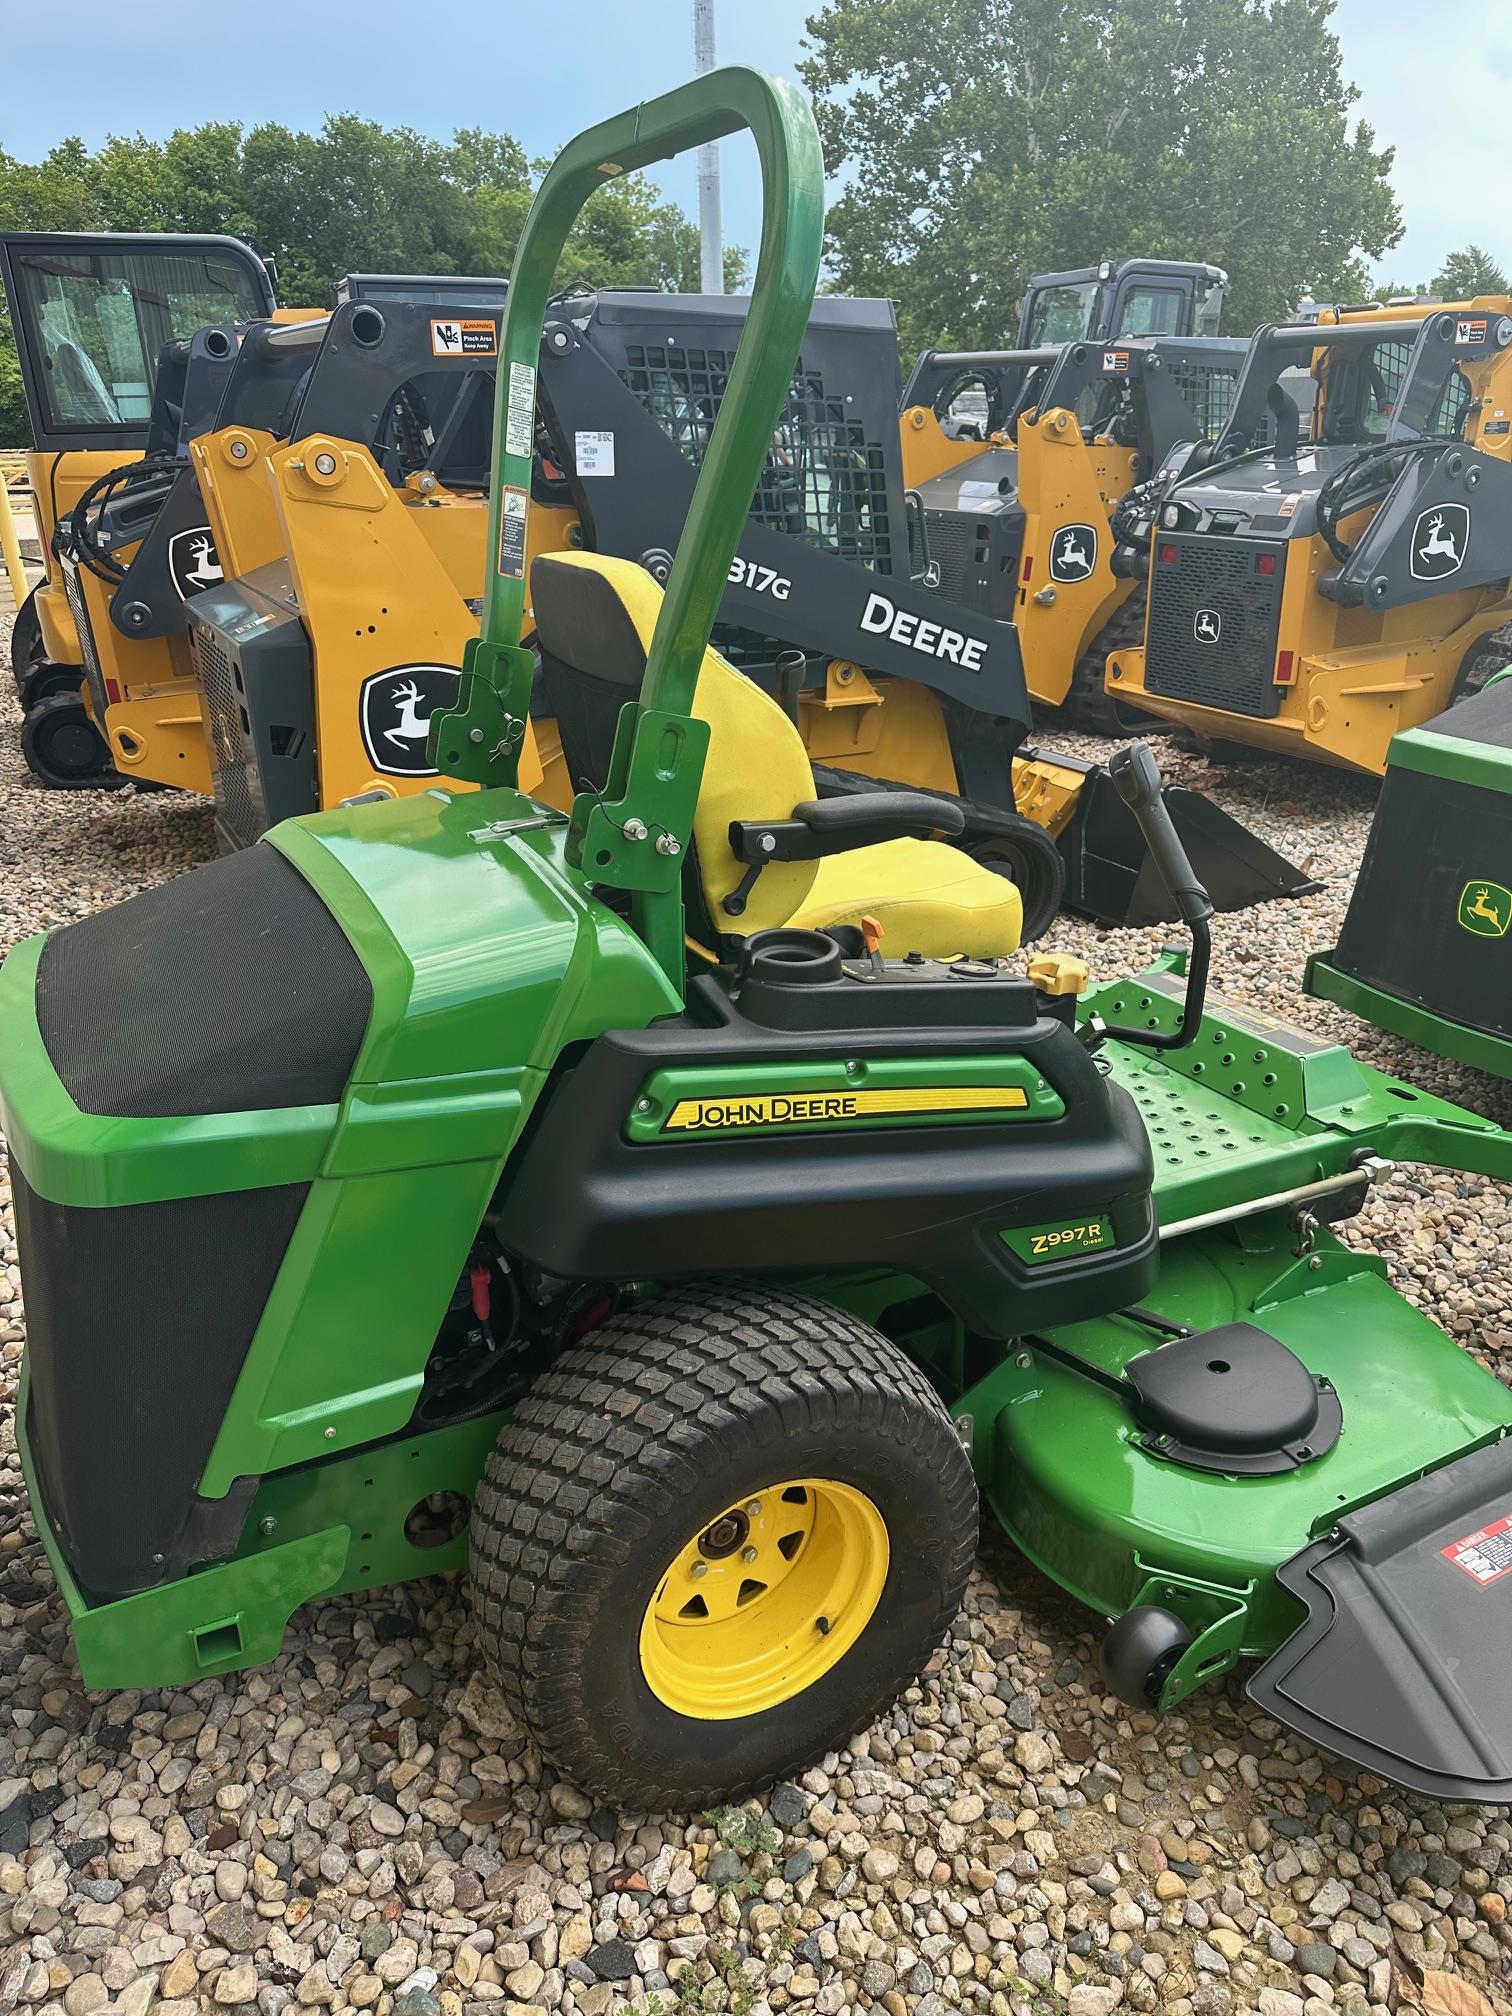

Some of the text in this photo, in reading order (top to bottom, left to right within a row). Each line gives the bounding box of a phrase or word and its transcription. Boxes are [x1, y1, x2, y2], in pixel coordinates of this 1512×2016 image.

[727, 557, 792, 600] 317G
[860, 593, 988, 671] DEERE
[688, 1097, 857, 1125] JOHN DEERE
[1082, 1236, 1104, 1246] Diesel
